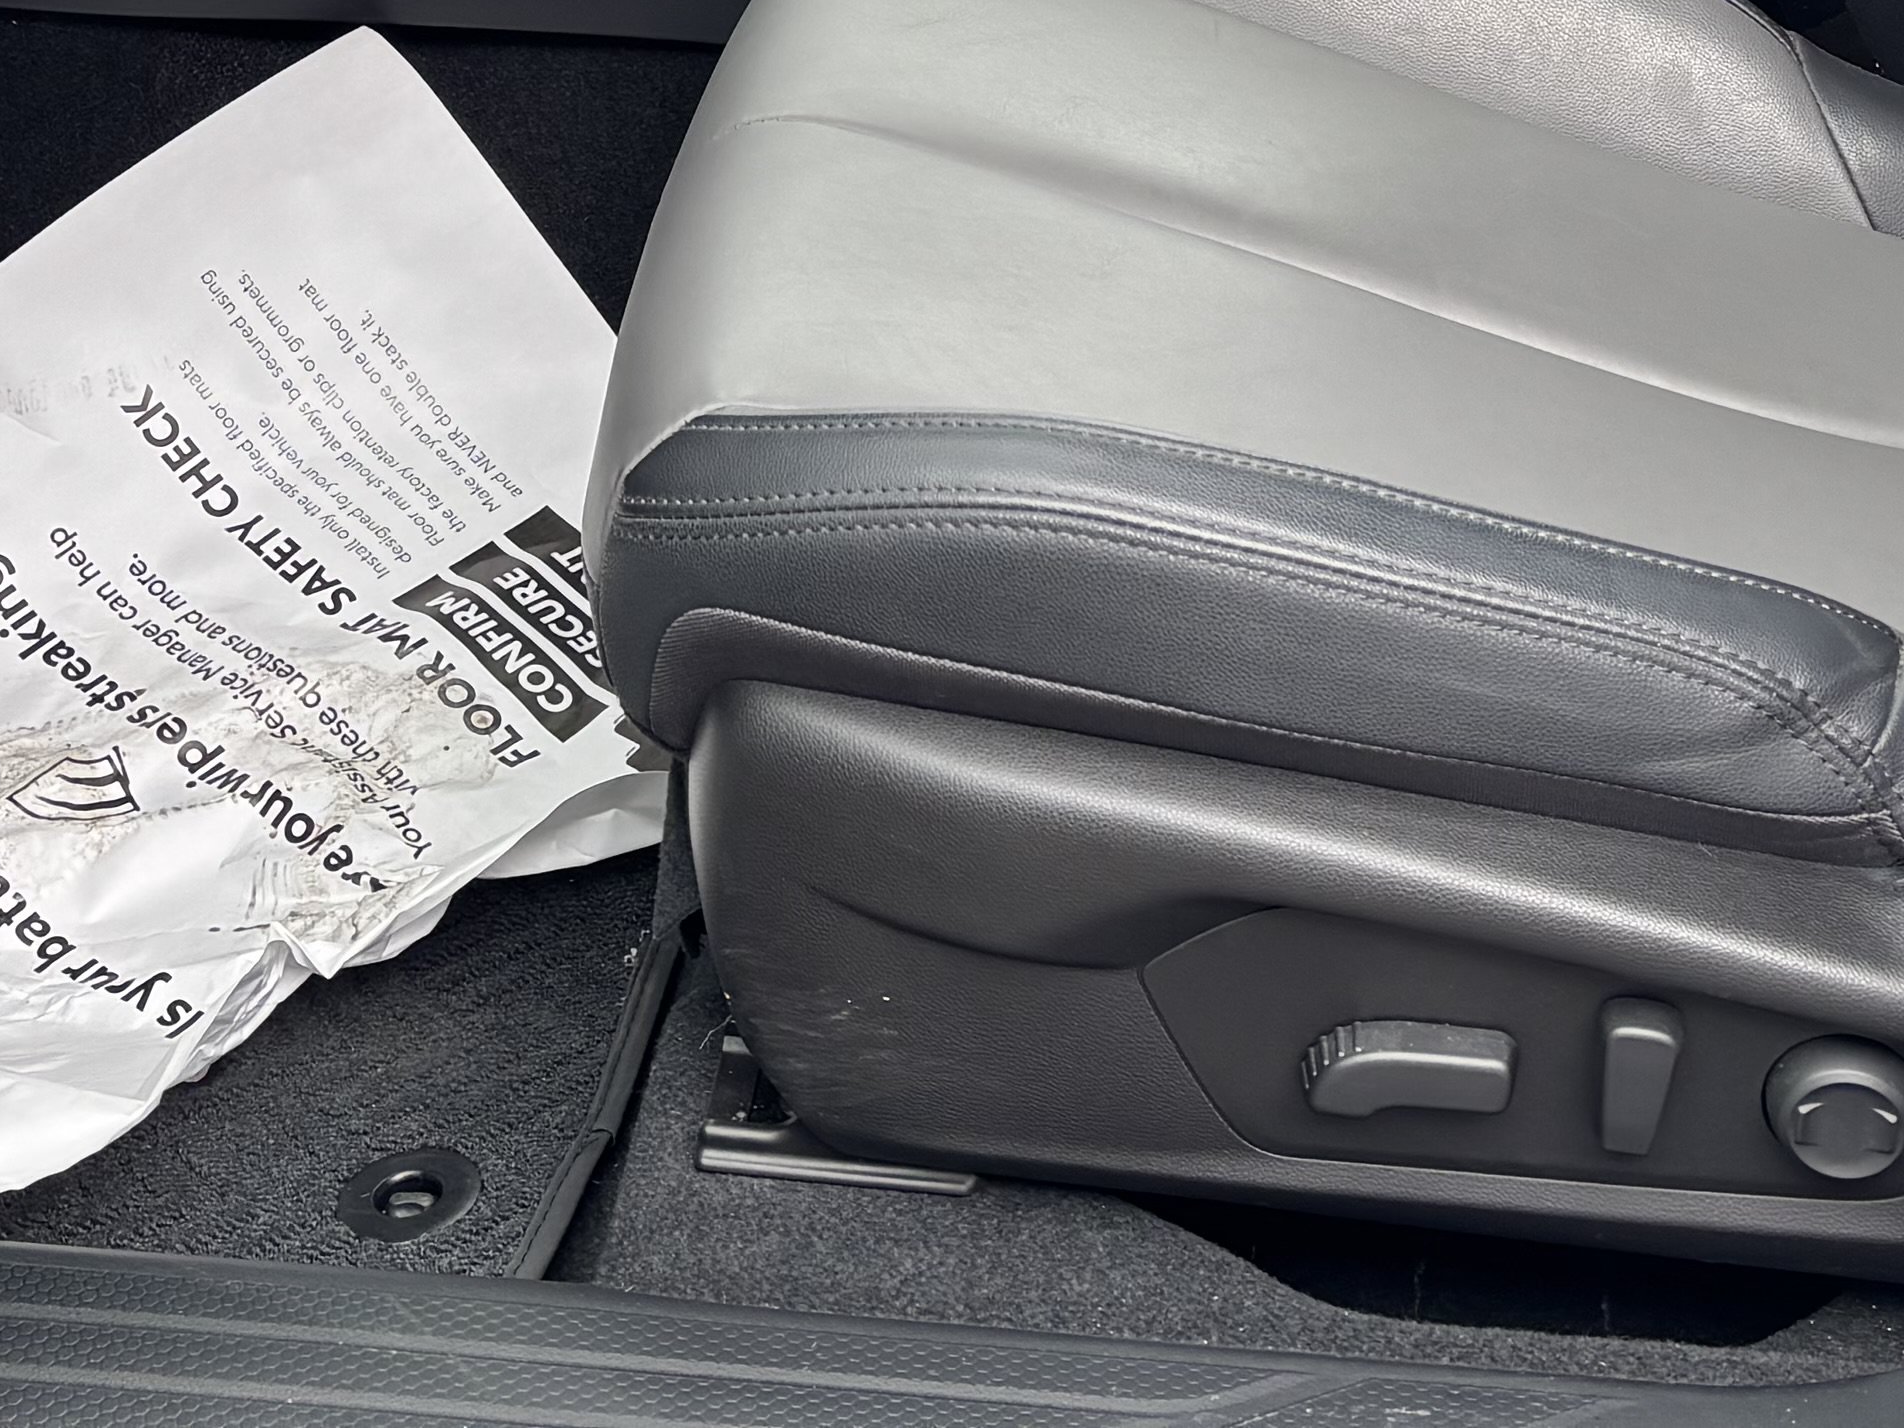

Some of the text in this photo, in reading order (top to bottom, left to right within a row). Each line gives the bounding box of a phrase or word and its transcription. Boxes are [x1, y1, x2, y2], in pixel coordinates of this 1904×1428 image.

[200, 270, 444, 546] Floor mat should always be secured using
[238, 269, 466, 532] the factory retention clips or grommets.
[299, 278, 501, 512] Make sure you have one floor mat
[360, 310, 523, 497] and NEVER double stack it.
[179, 360, 390, 579] Install only the specified floor mats
[259, 412, 411, 563] designed for your vehicle.
[50, 528, 101, 587] help
[120, 384, 541, 768] FLOOR MAT SAFETY CHECK
[129, 553, 187, 611] more.
[96, 581, 138, 620] can
[174, 609, 226, 639] and
[131, 619, 224, 681] Manager
[221, 635, 321, 708] questions
[425, 577, 572, 712] CONFIRM
[220, 672, 297, 747] Service
[126, 705, 249, 801] wipers
[231, 780, 345, 856] your
[380, 797, 432, 860] Your
[156, 999, 205, 1047] Is
